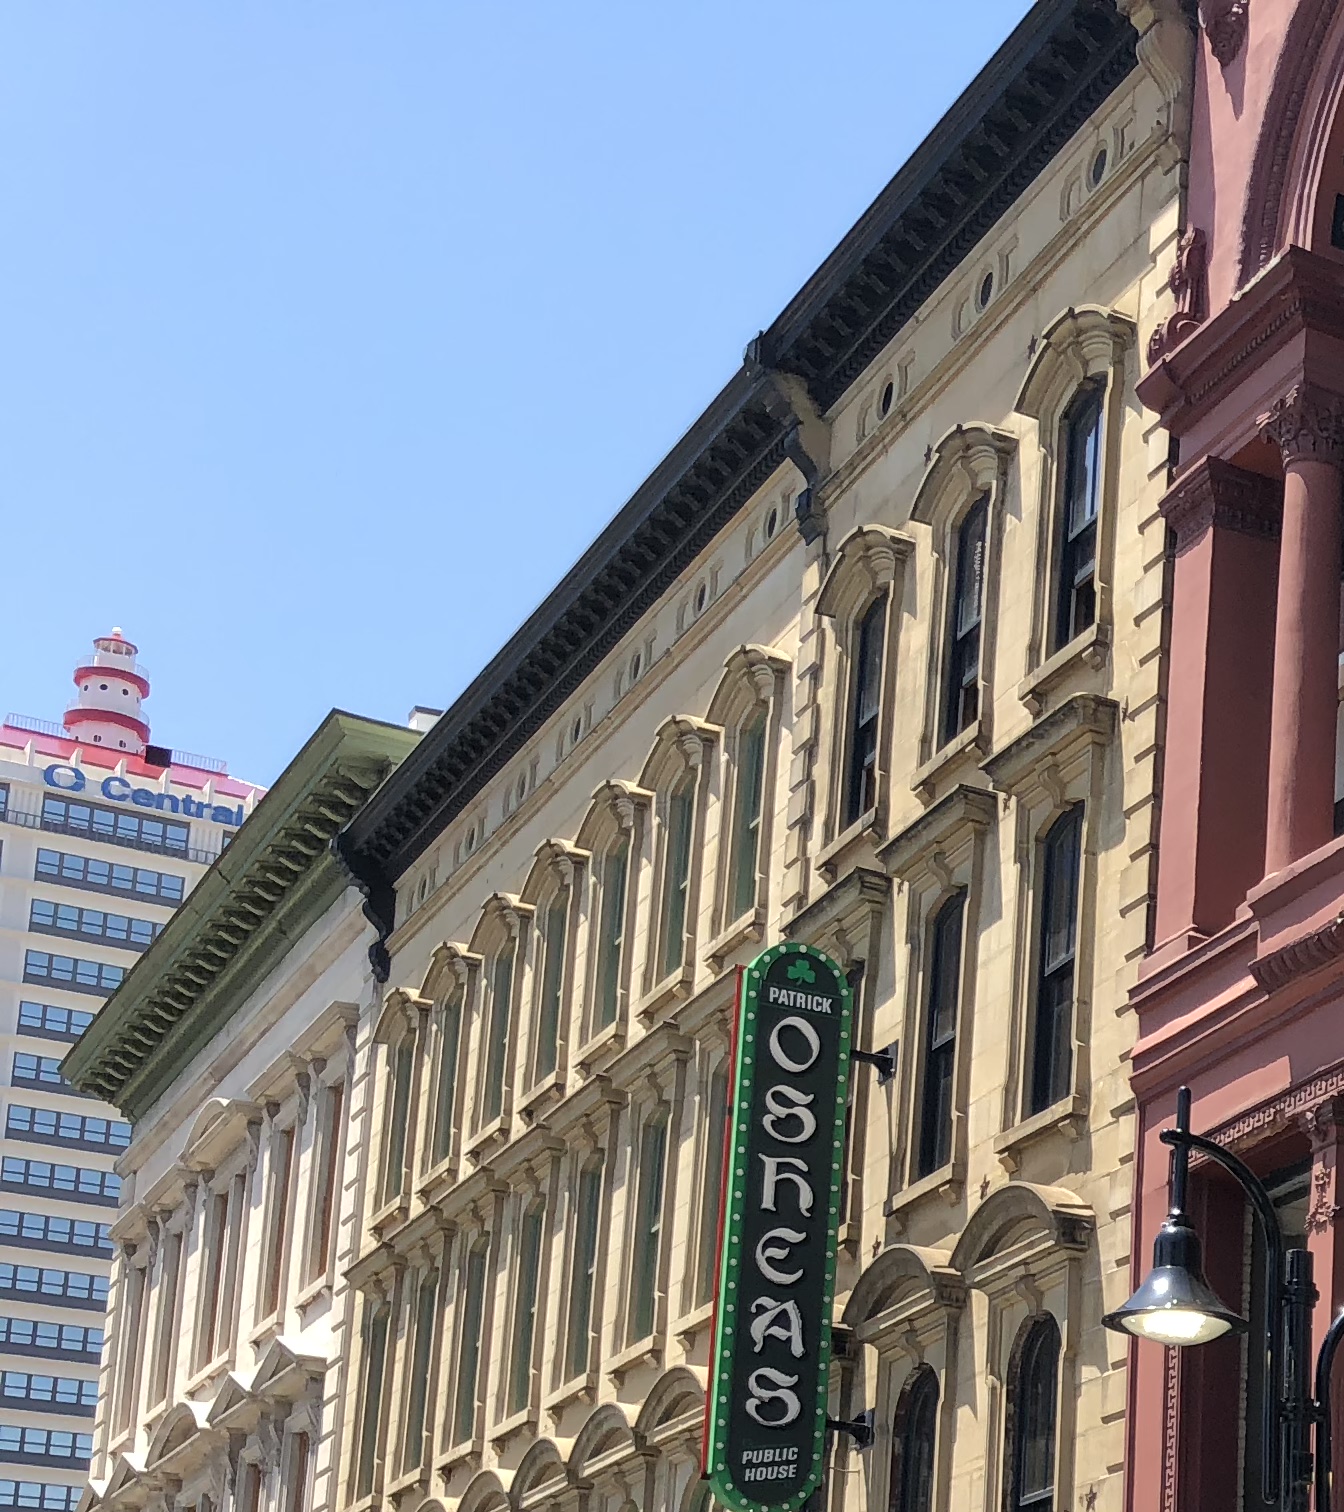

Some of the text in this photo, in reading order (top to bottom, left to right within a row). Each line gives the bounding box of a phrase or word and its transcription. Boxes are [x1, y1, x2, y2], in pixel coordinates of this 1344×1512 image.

[101, 776, 245, 827] Central
[769, 986, 833, 1014] PATRICK
[742, 1447, 799, 1465] PUBLIC
[744, 1464, 798, 1482] HOUSE
